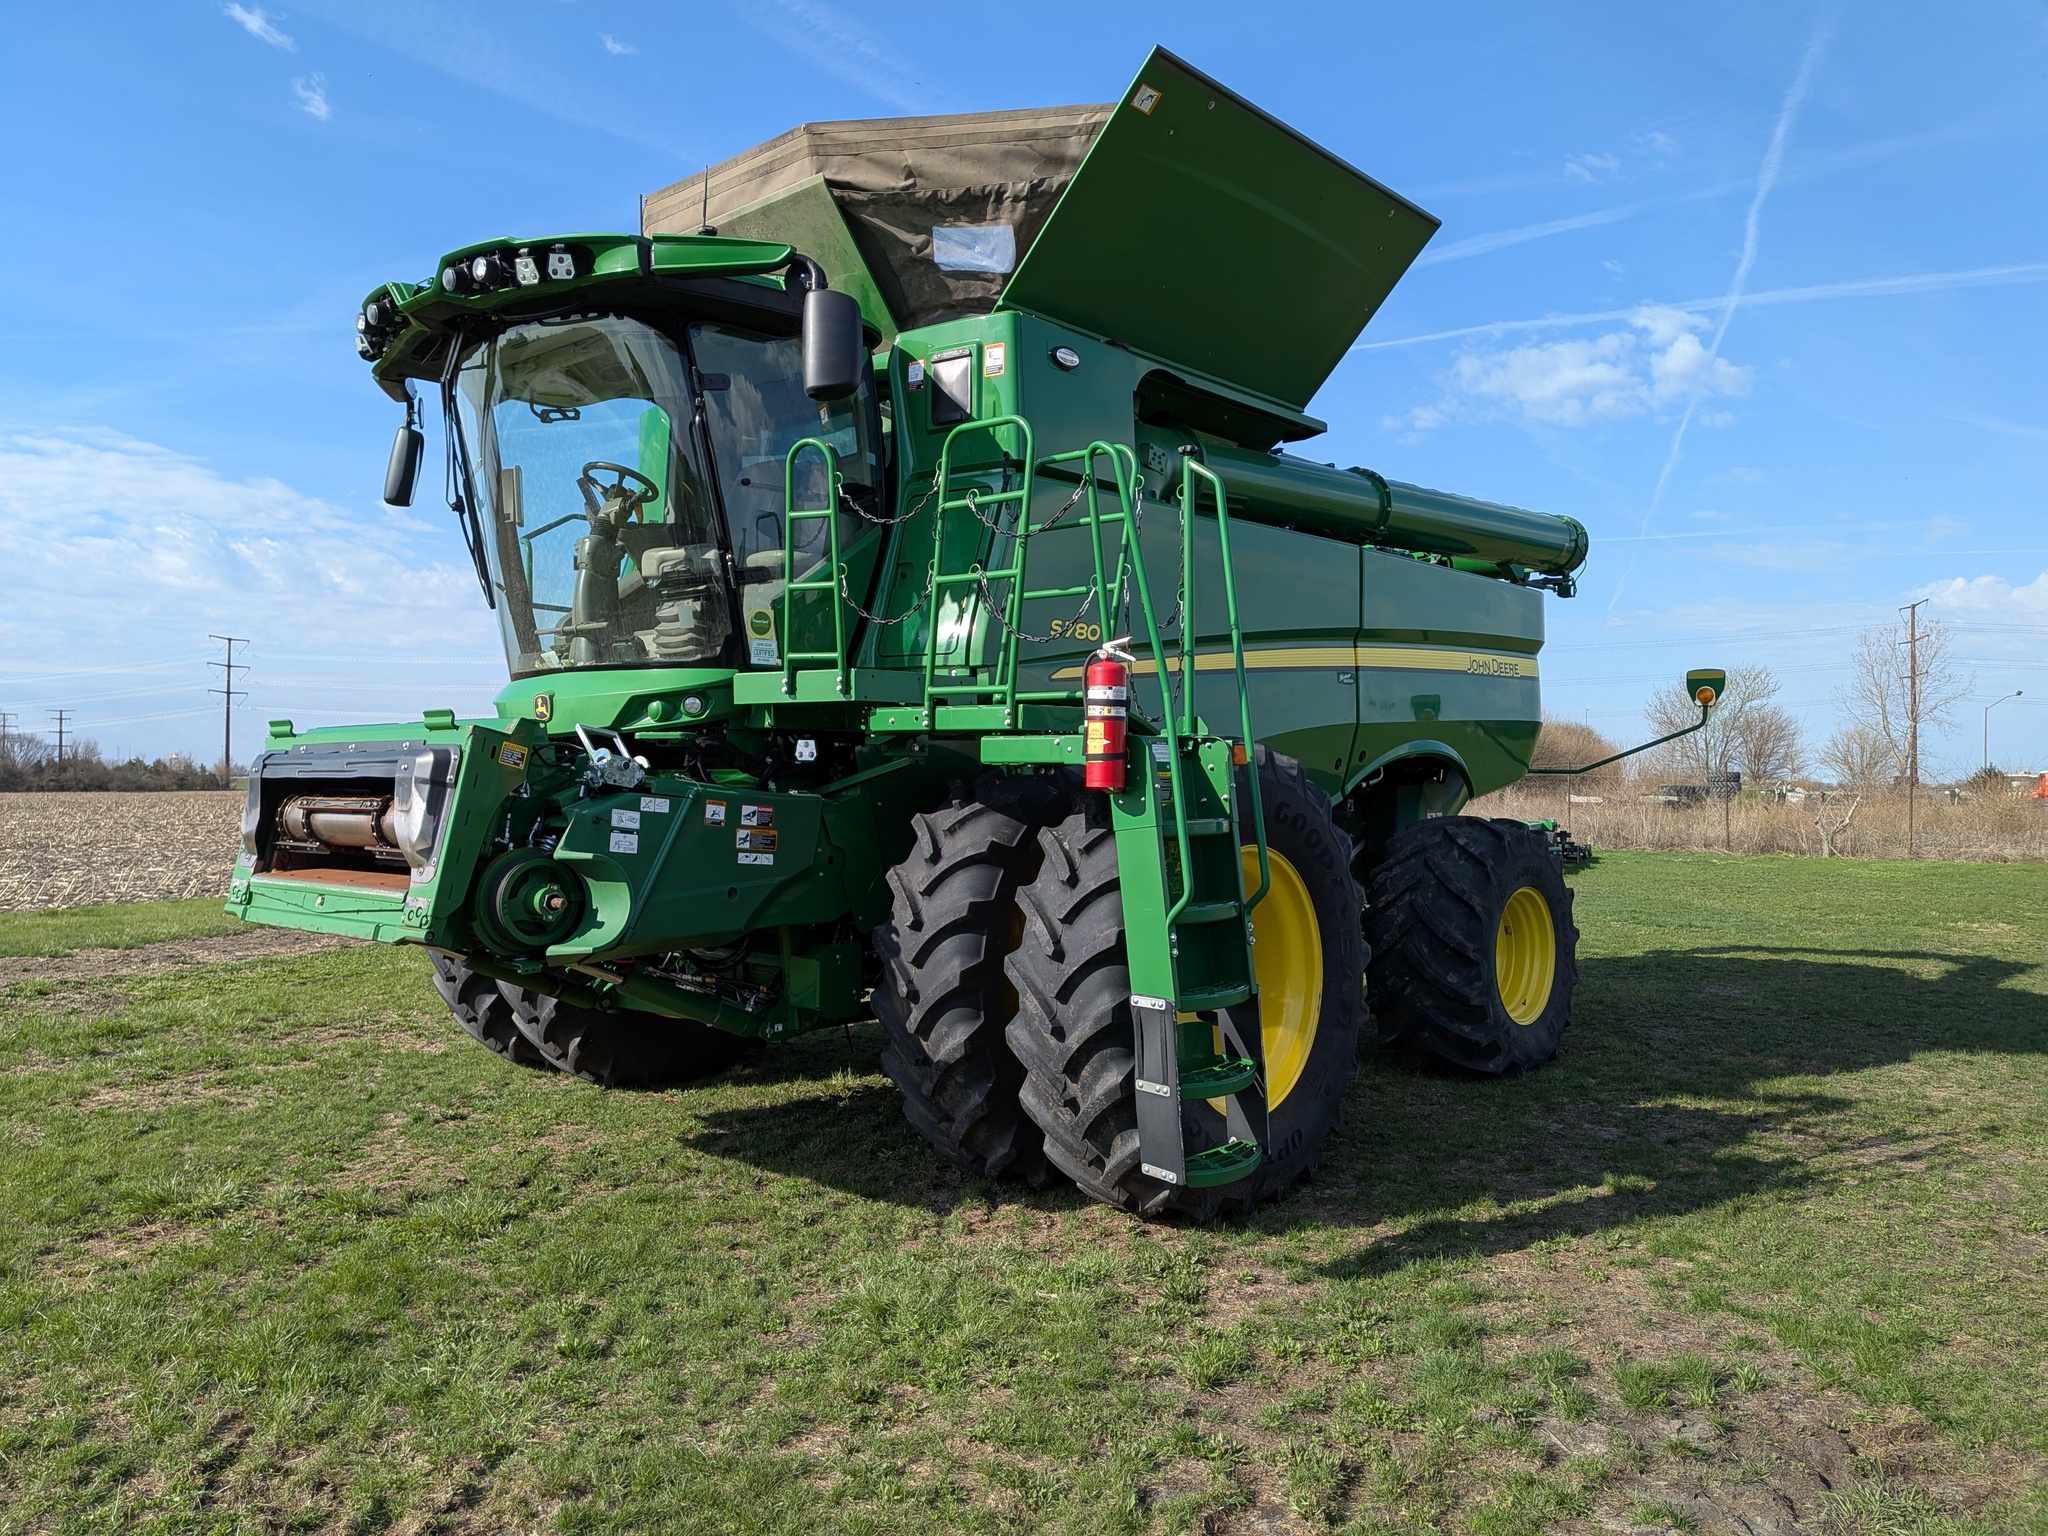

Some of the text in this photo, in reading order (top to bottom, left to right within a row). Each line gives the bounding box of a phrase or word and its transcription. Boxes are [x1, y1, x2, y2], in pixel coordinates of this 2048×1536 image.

[1050, 619, 1101, 642] S780
[1466, 656, 1520, 676] JOHN DEERE
